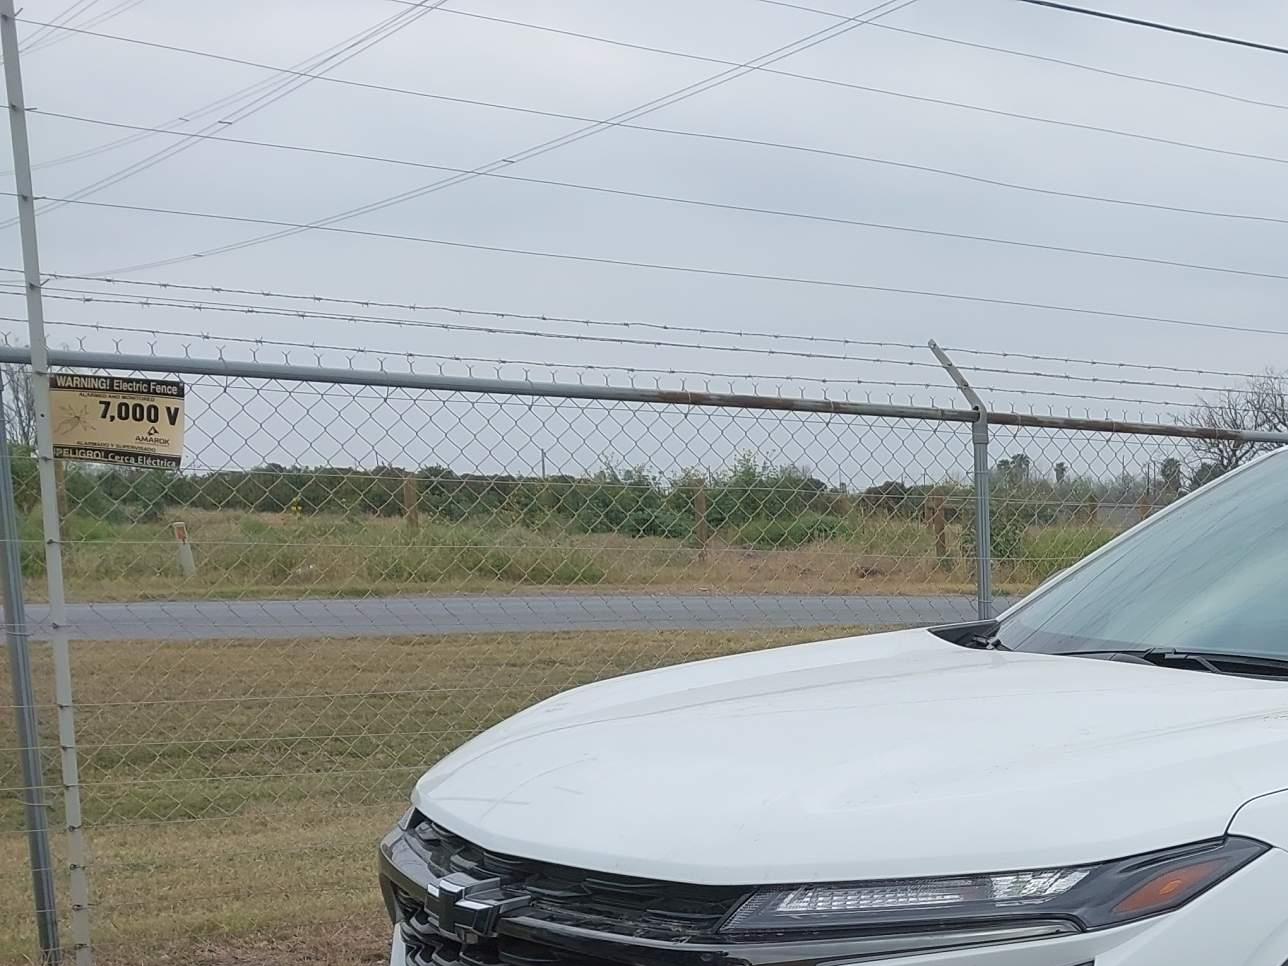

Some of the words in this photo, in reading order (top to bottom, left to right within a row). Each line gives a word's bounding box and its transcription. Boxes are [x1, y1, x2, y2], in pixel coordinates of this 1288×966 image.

[56, 375, 110, 389] WARNING!
[113, 379, 148, 392] Electric
[150, 382, 178, 395] Fence
[98, 400, 159, 424] 7,000
[165, 406, 180, 426] V
[135, 435, 170, 446] AMAROK
[107, 452, 135, 464] Cerca
